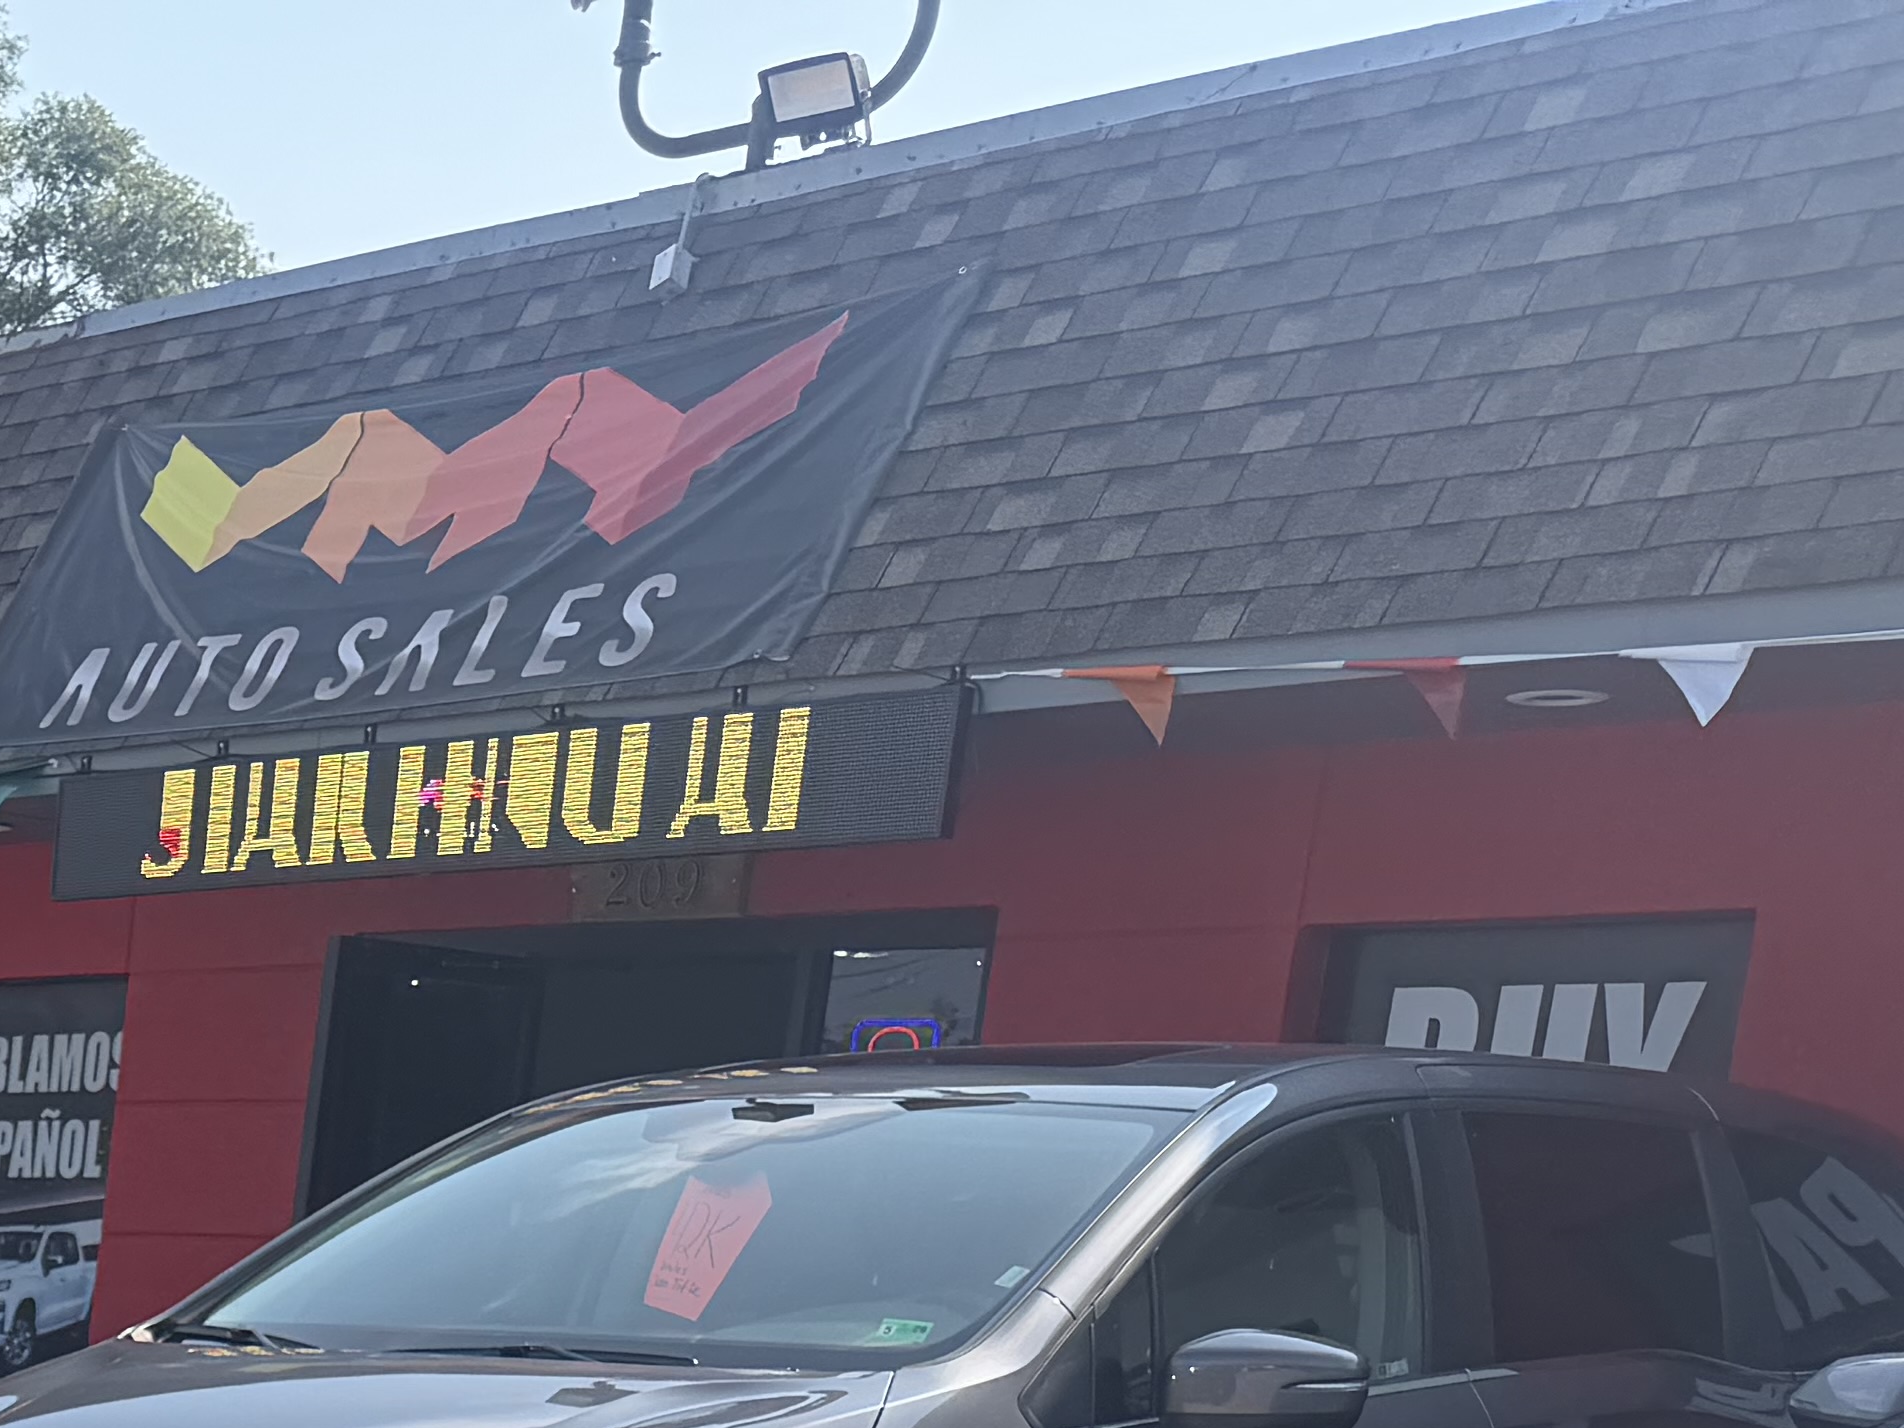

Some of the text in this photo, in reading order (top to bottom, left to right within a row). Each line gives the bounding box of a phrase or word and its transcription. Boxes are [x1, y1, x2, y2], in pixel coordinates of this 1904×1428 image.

[39, 573, 678, 729] AUTO SALES
[605, 859, 702, 909] 209
